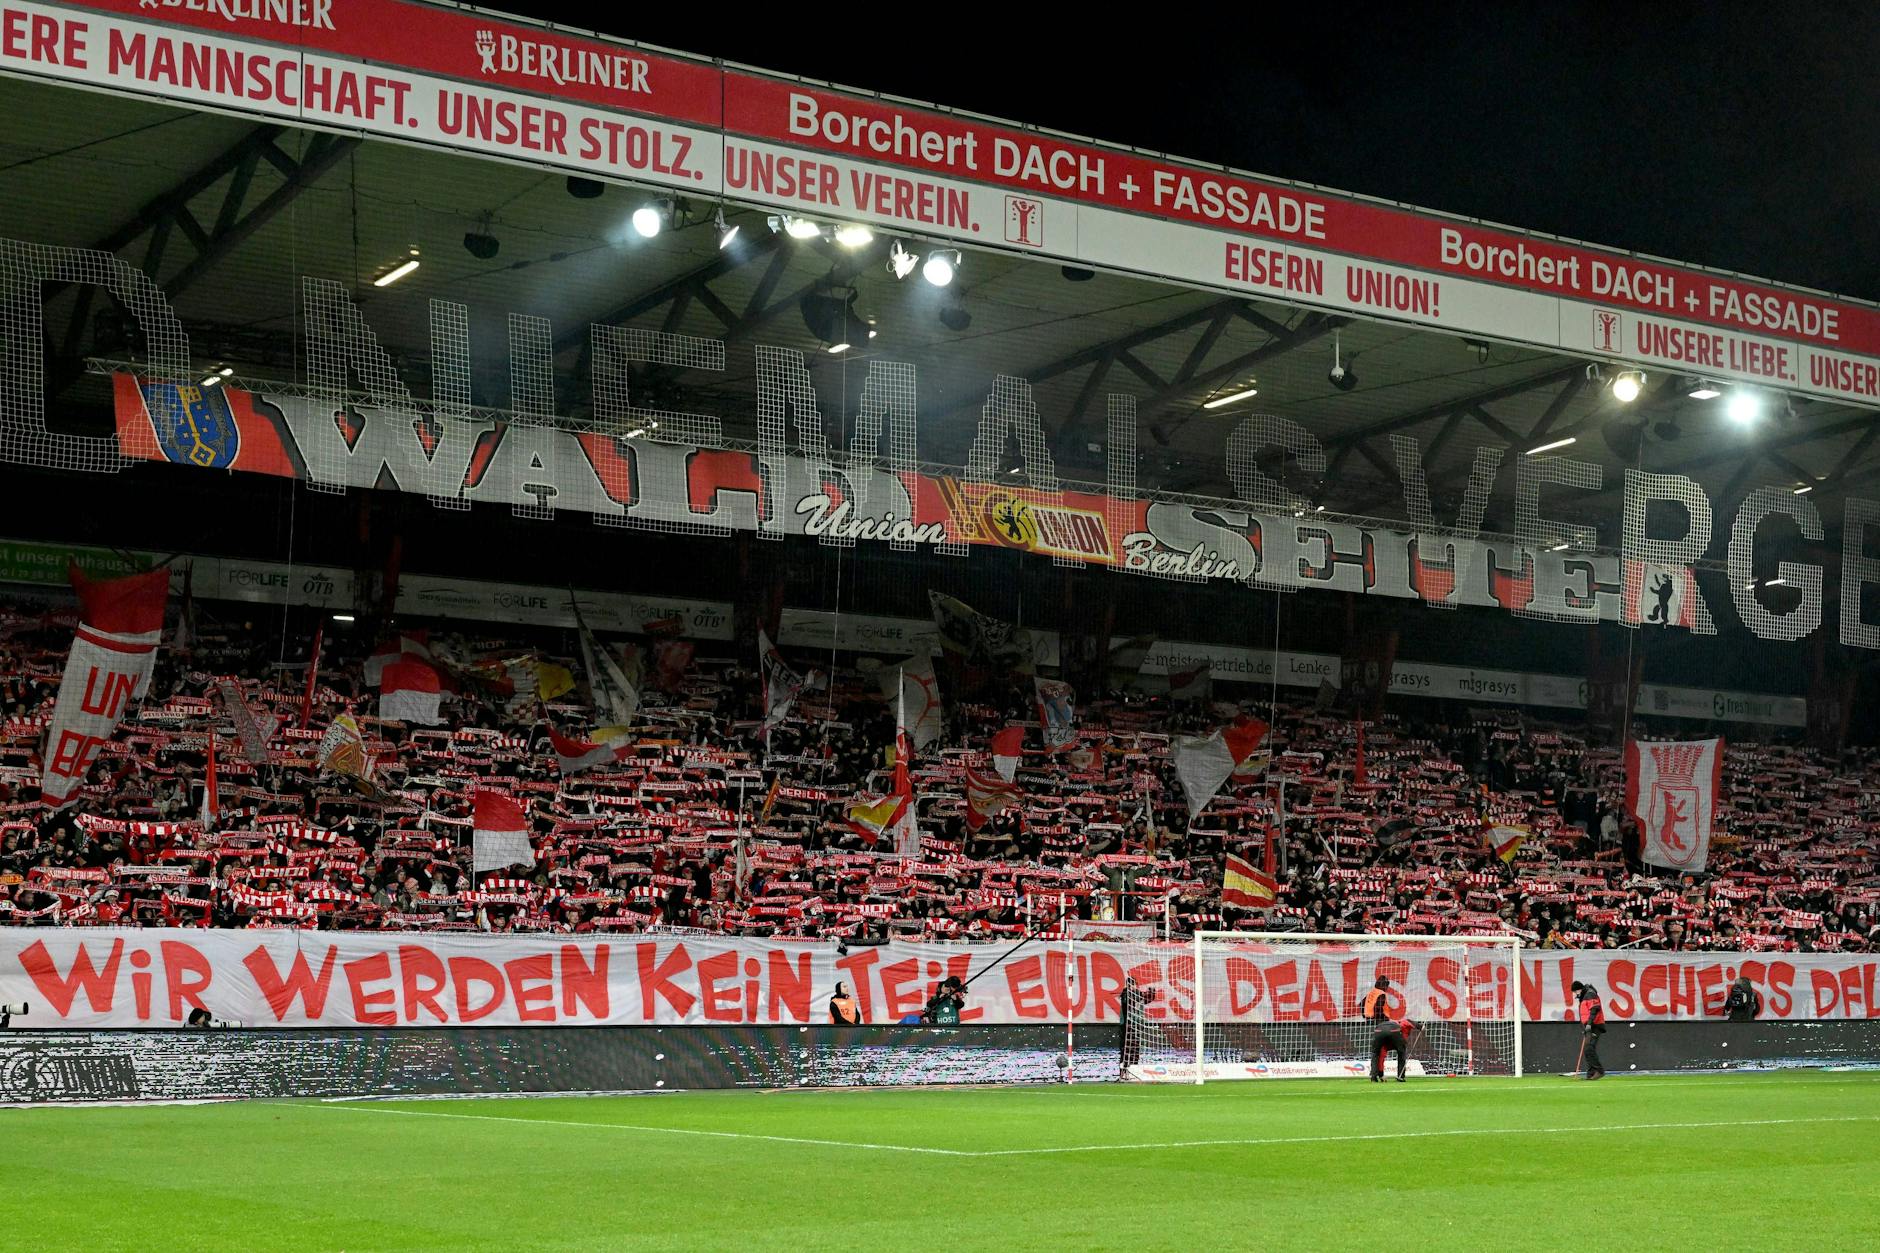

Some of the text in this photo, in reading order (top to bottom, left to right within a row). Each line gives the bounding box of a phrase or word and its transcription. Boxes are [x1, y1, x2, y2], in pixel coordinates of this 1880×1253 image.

[500, 34, 652, 95] BERLINER
[3, 9, 704, 181] ERE MANNSCHAFT. UNSER STOLZ.
[726, 146, 980, 232] UNSER VEREIN.
[789, 93, 978, 171] Borchert
[994, 138, 1105, 194] DACH
[1153, 170, 1326, 240] FASSADE
[1225, 242, 1440, 317] EISERN UNION!
[1440, 228, 1580, 290] Borchert
[1591, 261, 1674, 309] DACH
[1709, 285, 1840, 340] FASSADE
[1638, 322, 1880, 397] UNSERE LIEBE. UNSER
[795, 494, 947, 546] Union
[1032, 506, 1111, 556] UNION
[229, 569, 289, 587] FORLIFE
[1121, 531, 1243, 581] Berlin
[303, 580, 334, 595] OTB
[493, 592, 548, 609] FORLIFE
[1290, 658, 1330, 676] Lenke
[1459, 671, 1517, 695] migrasys
[242, 943, 610, 1025] WERDEN
[1225, 955, 1410, 1021] DEALS
[937, 1016, 956, 1024] HOST
[1269, 1066, 1318, 1077] TotalEnergies
